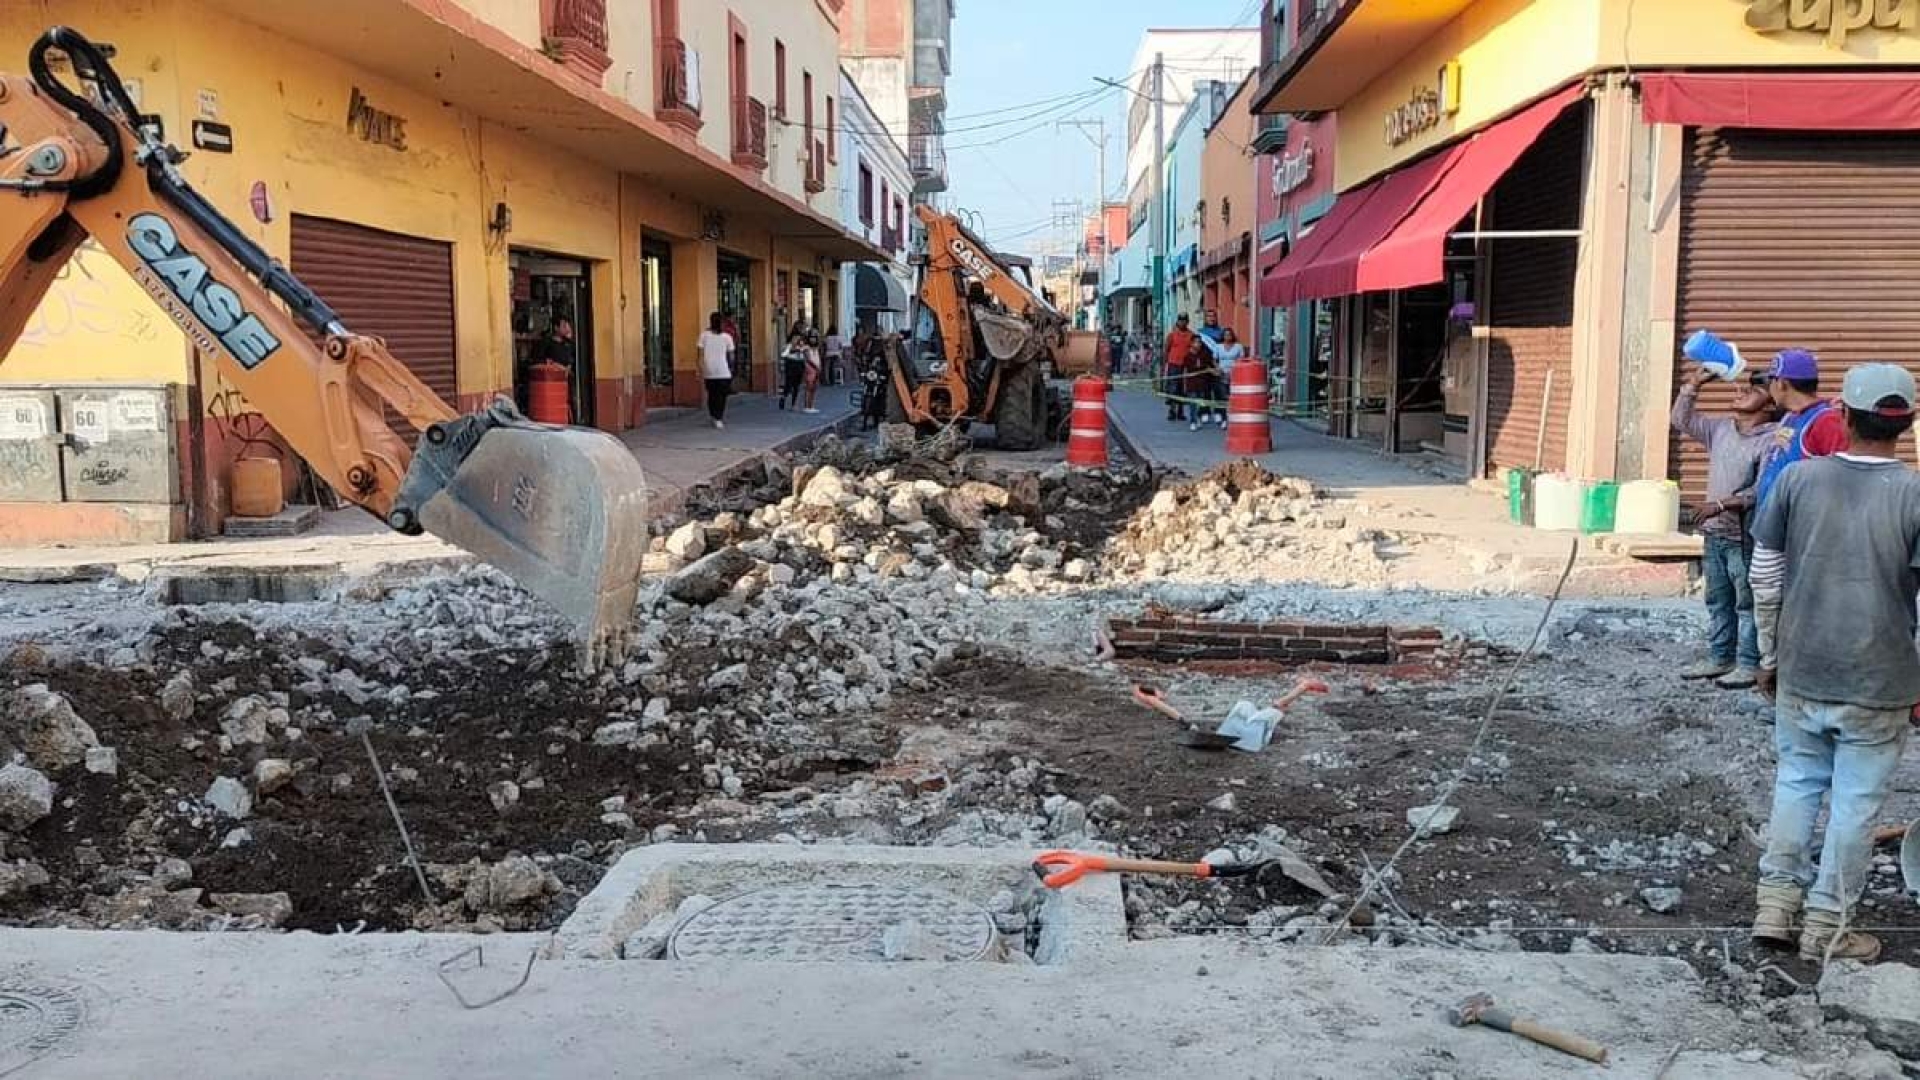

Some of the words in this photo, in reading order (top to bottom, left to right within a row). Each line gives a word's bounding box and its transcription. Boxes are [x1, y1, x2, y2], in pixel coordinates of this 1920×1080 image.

[951, 239, 993, 280] CASE
[126, 211, 282, 370] CASE
[76, 411, 96, 427] 60
